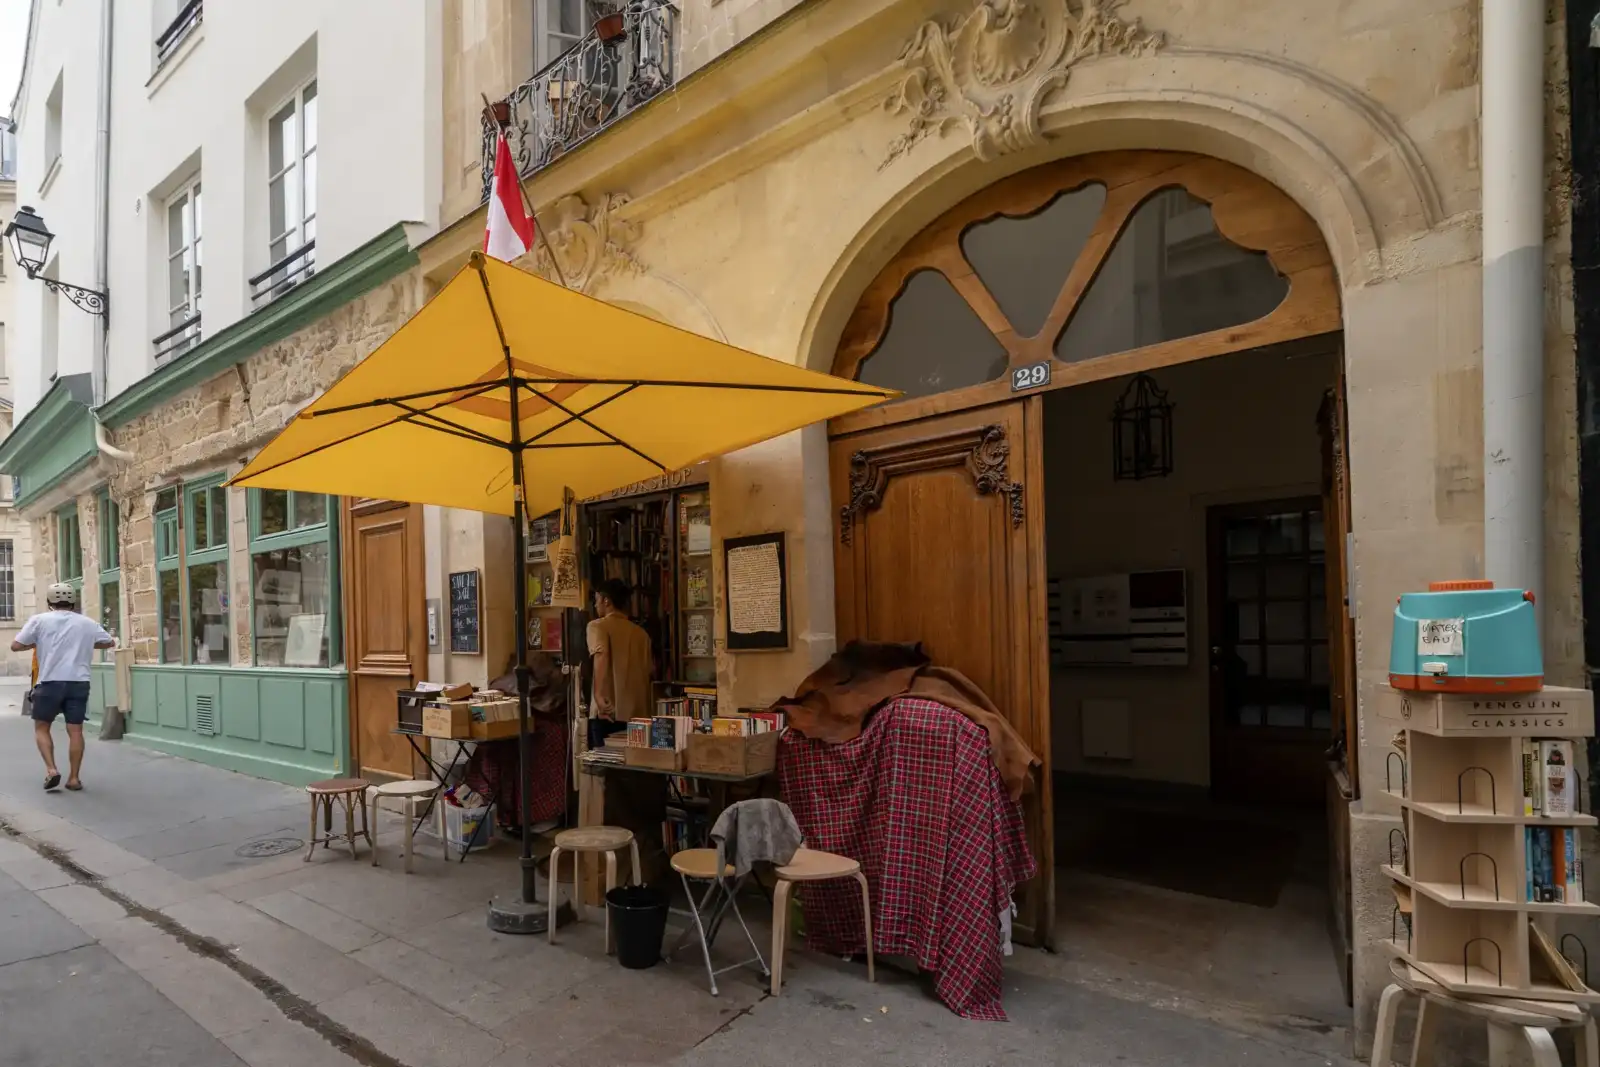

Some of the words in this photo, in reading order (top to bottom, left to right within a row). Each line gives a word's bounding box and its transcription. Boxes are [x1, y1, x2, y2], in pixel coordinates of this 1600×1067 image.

[1016, 365, 1046, 387] 29
[1422, 635, 1450, 644] EAU
[1473, 700, 1562, 710] PENGUIN
[1471, 718, 1566, 728] CLASSICS
